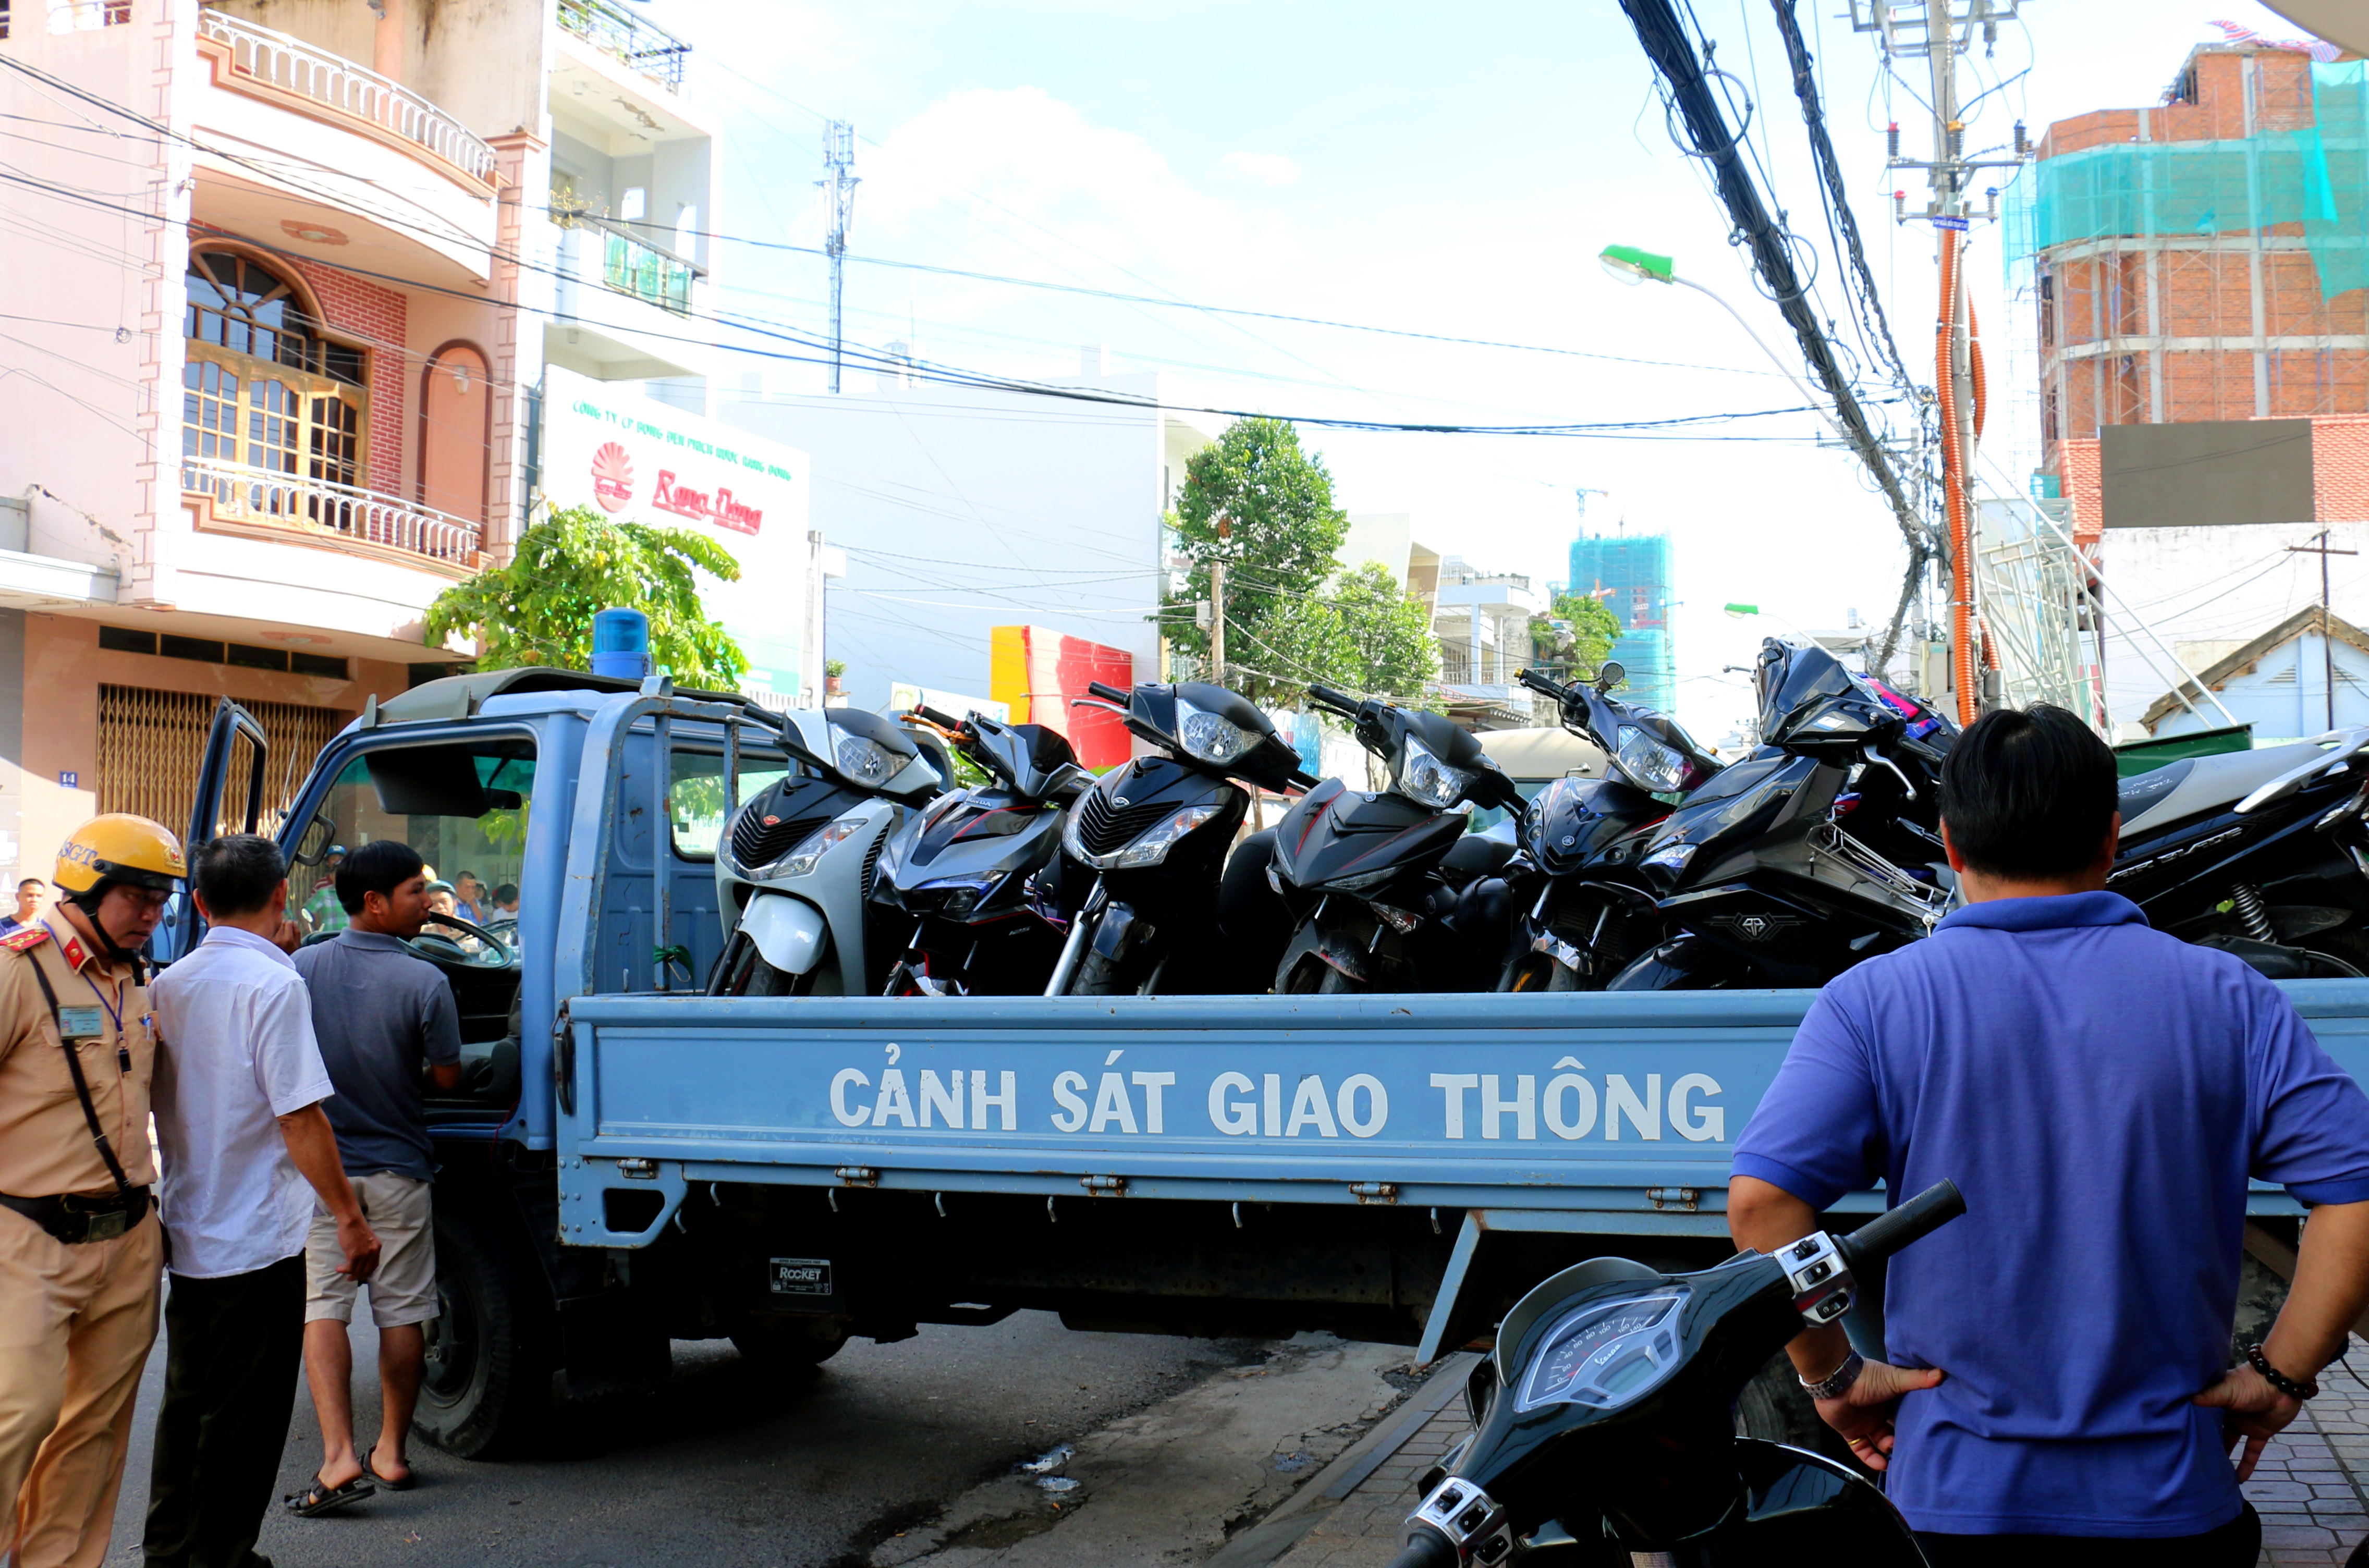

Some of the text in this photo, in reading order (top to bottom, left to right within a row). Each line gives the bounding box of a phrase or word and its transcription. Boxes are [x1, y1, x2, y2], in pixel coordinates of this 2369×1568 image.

[605, 410, 617, 423] TY
[621, 417, 634, 428] CP
[63, 773, 75, 782] 14
[829, 1043, 1724, 1142] CẢNH SÁT GIAO THÔNG
[1598, 1326, 1611, 1335] 100
[1618, 1324, 1630, 1334] 120
[1629, 1323, 1642, 1333] 140
[1573, 1340, 1583, 1349] 60
[1564, 1351, 1573, 1359] 40
[1594, 1343, 1623, 1366] Vespa
[1562, 1364, 1571, 1372] 20
